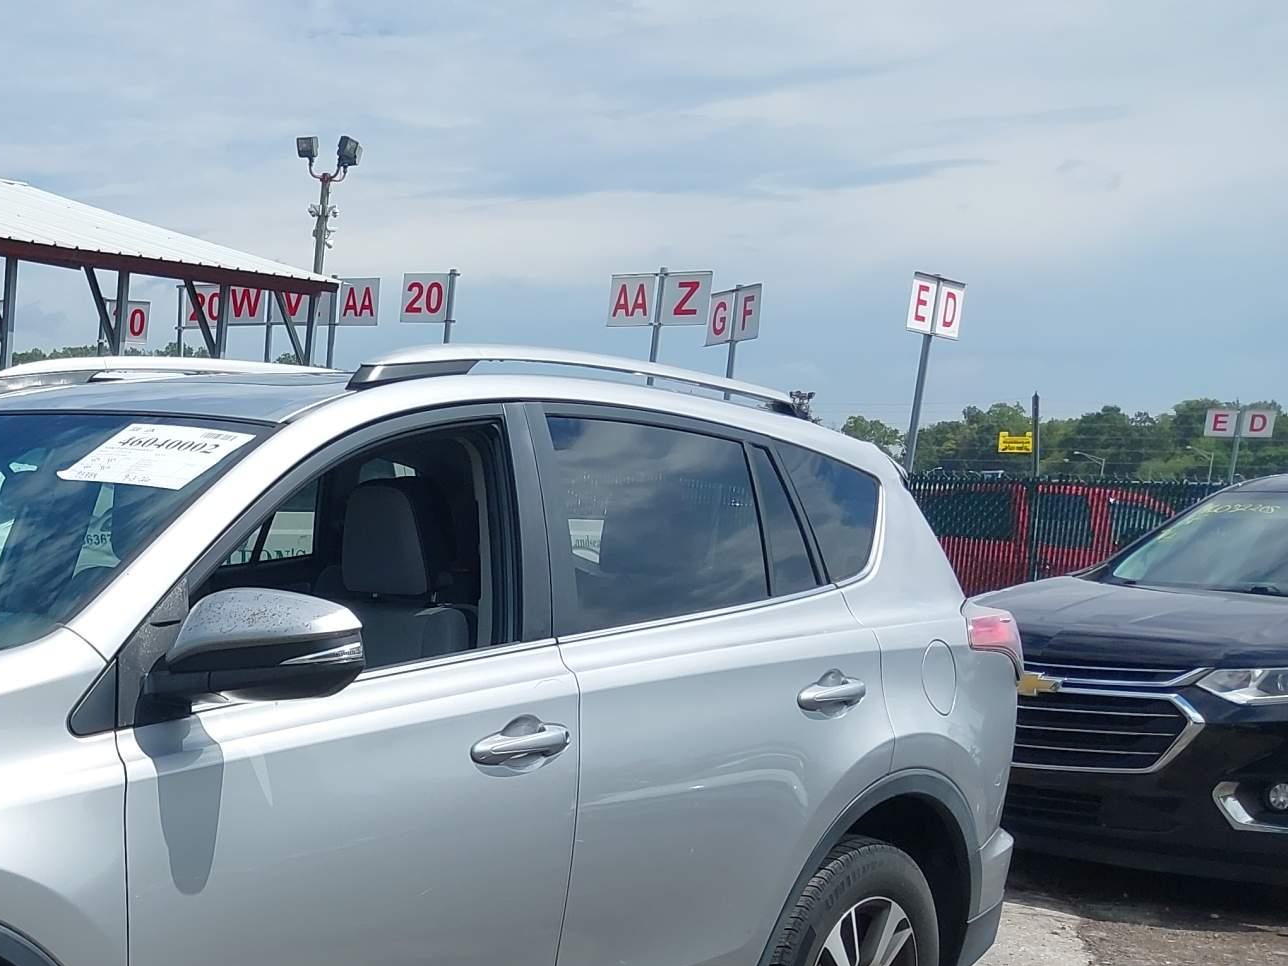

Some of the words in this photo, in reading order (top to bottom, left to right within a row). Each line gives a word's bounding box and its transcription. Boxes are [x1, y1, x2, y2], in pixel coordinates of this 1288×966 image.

[231, 287, 262, 318] W
[342, 286, 374, 317] AA
[404, 281, 444, 314] 20
[612, 283, 648, 317] AA
[673, 281, 700, 316] Z
[741, 295, 755, 331] F
[913, 284, 930, 322] E
[942, 291, 957, 328] D
[712, 301, 727, 336] G
[1212, 413, 1229, 432] E
[1249, 413, 1268, 432] D
[118, 436, 220, 454] 46040002
